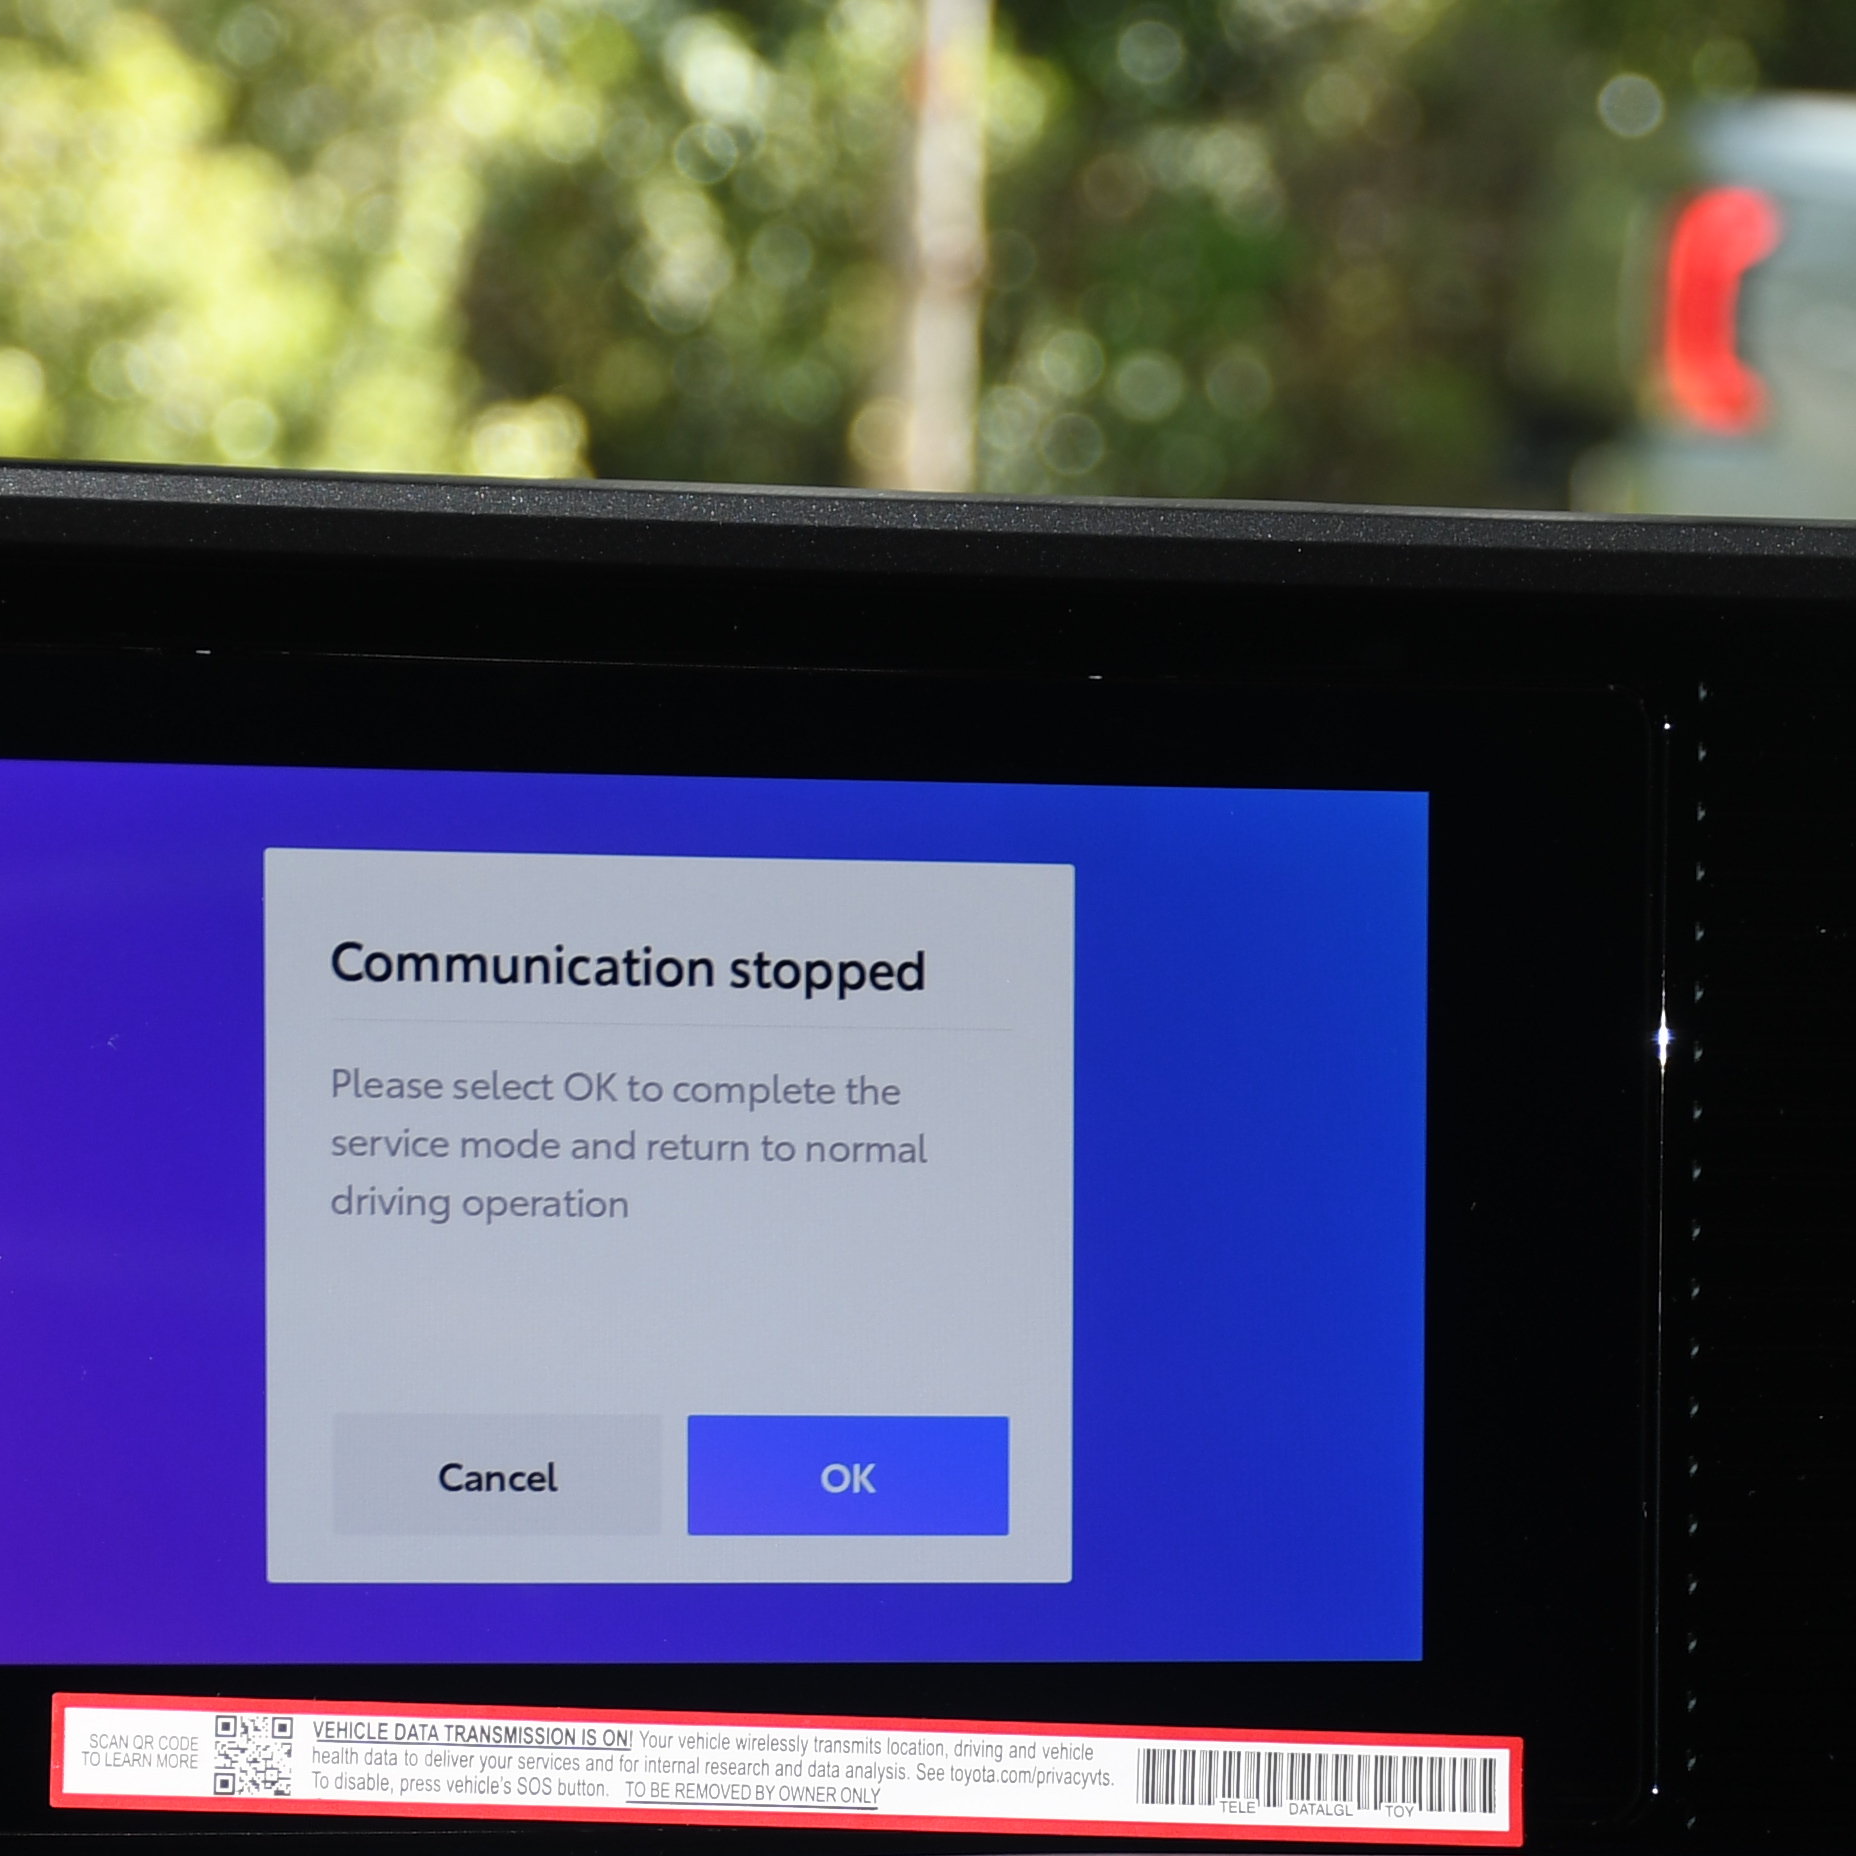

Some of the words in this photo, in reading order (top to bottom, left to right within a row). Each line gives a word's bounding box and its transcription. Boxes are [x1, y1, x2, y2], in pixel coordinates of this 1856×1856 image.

[331, 941, 713, 987] Communication
[730, 950, 925, 1000] stopped
[331, 1067, 444, 1100] Please
[452, 1069, 555, 1101] select
[564, 1071, 618, 1101] OK
[627, 1075, 664, 1103] to
[673, 1073, 836, 1112] complete
[845, 1075, 901, 1105] the
[331, 1128, 450, 1158] service
[460, 1128, 561, 1159] mode
[571, 1130, 636, 1160] and
[647, 1134, 749, 1161] return
[761, 1135, 796, 1162] to
[805, 1133, 928, 1163] normal
[331, 1184, 451, 1225] driving
[462, 1188, 629, 1225] operation
[437, 1459, 560, 1496] Cancel
[820, 1463, 877, 1496] OK
[89, 1733, 128, 1750] SCAN
[133, 1734, 154, 1751] QR
[157, 1735, 199, 1751] CODE
[313, 1720, 388, 1740] VEHICLE
[394, 1723, 439, 1741] DATA
[444, 1724, 576, 1746] TRANSMISSION
[581, 1728, 597, 1746] IS
[602, 1728, 633, 1748] ON!
[639, 1730, 673, 1749] Your
[678, 1732, 730, 1751] vehicle
[735, 1733, 809, 1757] wirelessly
[813, 1735, 882, 1755] transmits
[887, 1737, 948, 1760] location,
[954, 1740, 1003, 1763] driving
[1009, 1742, 1036, 1760] and
[1042, 1742, 1094, 1761] vehicle
[81, 1751, 101, 1767] TO
[105, 1752, 151, 1768] LEARN
[156, 1753, 199, 1769] MORE
[312, 1746, 359, 1765] health
[364, 1748, 398, 1766] data
[404, 1750, 419, 1766] to
[424, 1749, 474, 1769] deliver
[479, 1754, 513, 1774] your
[517, 1752, 580, 1771] services
[585, 1753, 614, 1772] and
[619, 1754, 639, 1773] for
[644, 1755, 700, 1775] internal
[704, 1759, 769, 1777] research
[775, 1759, 802, 1778] and
[808, 1761, 840, 1779] data
[845, 1762, 911, 1784] analysis.
[916, 1763, 945, 1781] See
[312, 1770, 329, 1790] To
[334, 1773, 394, 1795] disable,
[400, 1778, 441, 1796] press
[446, 1776, 512, 1796] vehicle's
[516, 1777, 552, 1796] SOS
[557, 1778, 610, 1799] button.
[625, 1781, 646, 1798] TO
[650, 1782, 670, 1799] BE
[675, 1783, 751, 1801] REMOVED
[755, 1785, 776, 1802] BY
[779, 1785, 836, 1803] OWNER
[840, 1787, 881, 1804] ONLY
[1219, 1801, 1256, 1814] TELE
[1289, 1803, 1353, 1817] DATALGL
[1385, 1804, 1416, 1818] TOY
